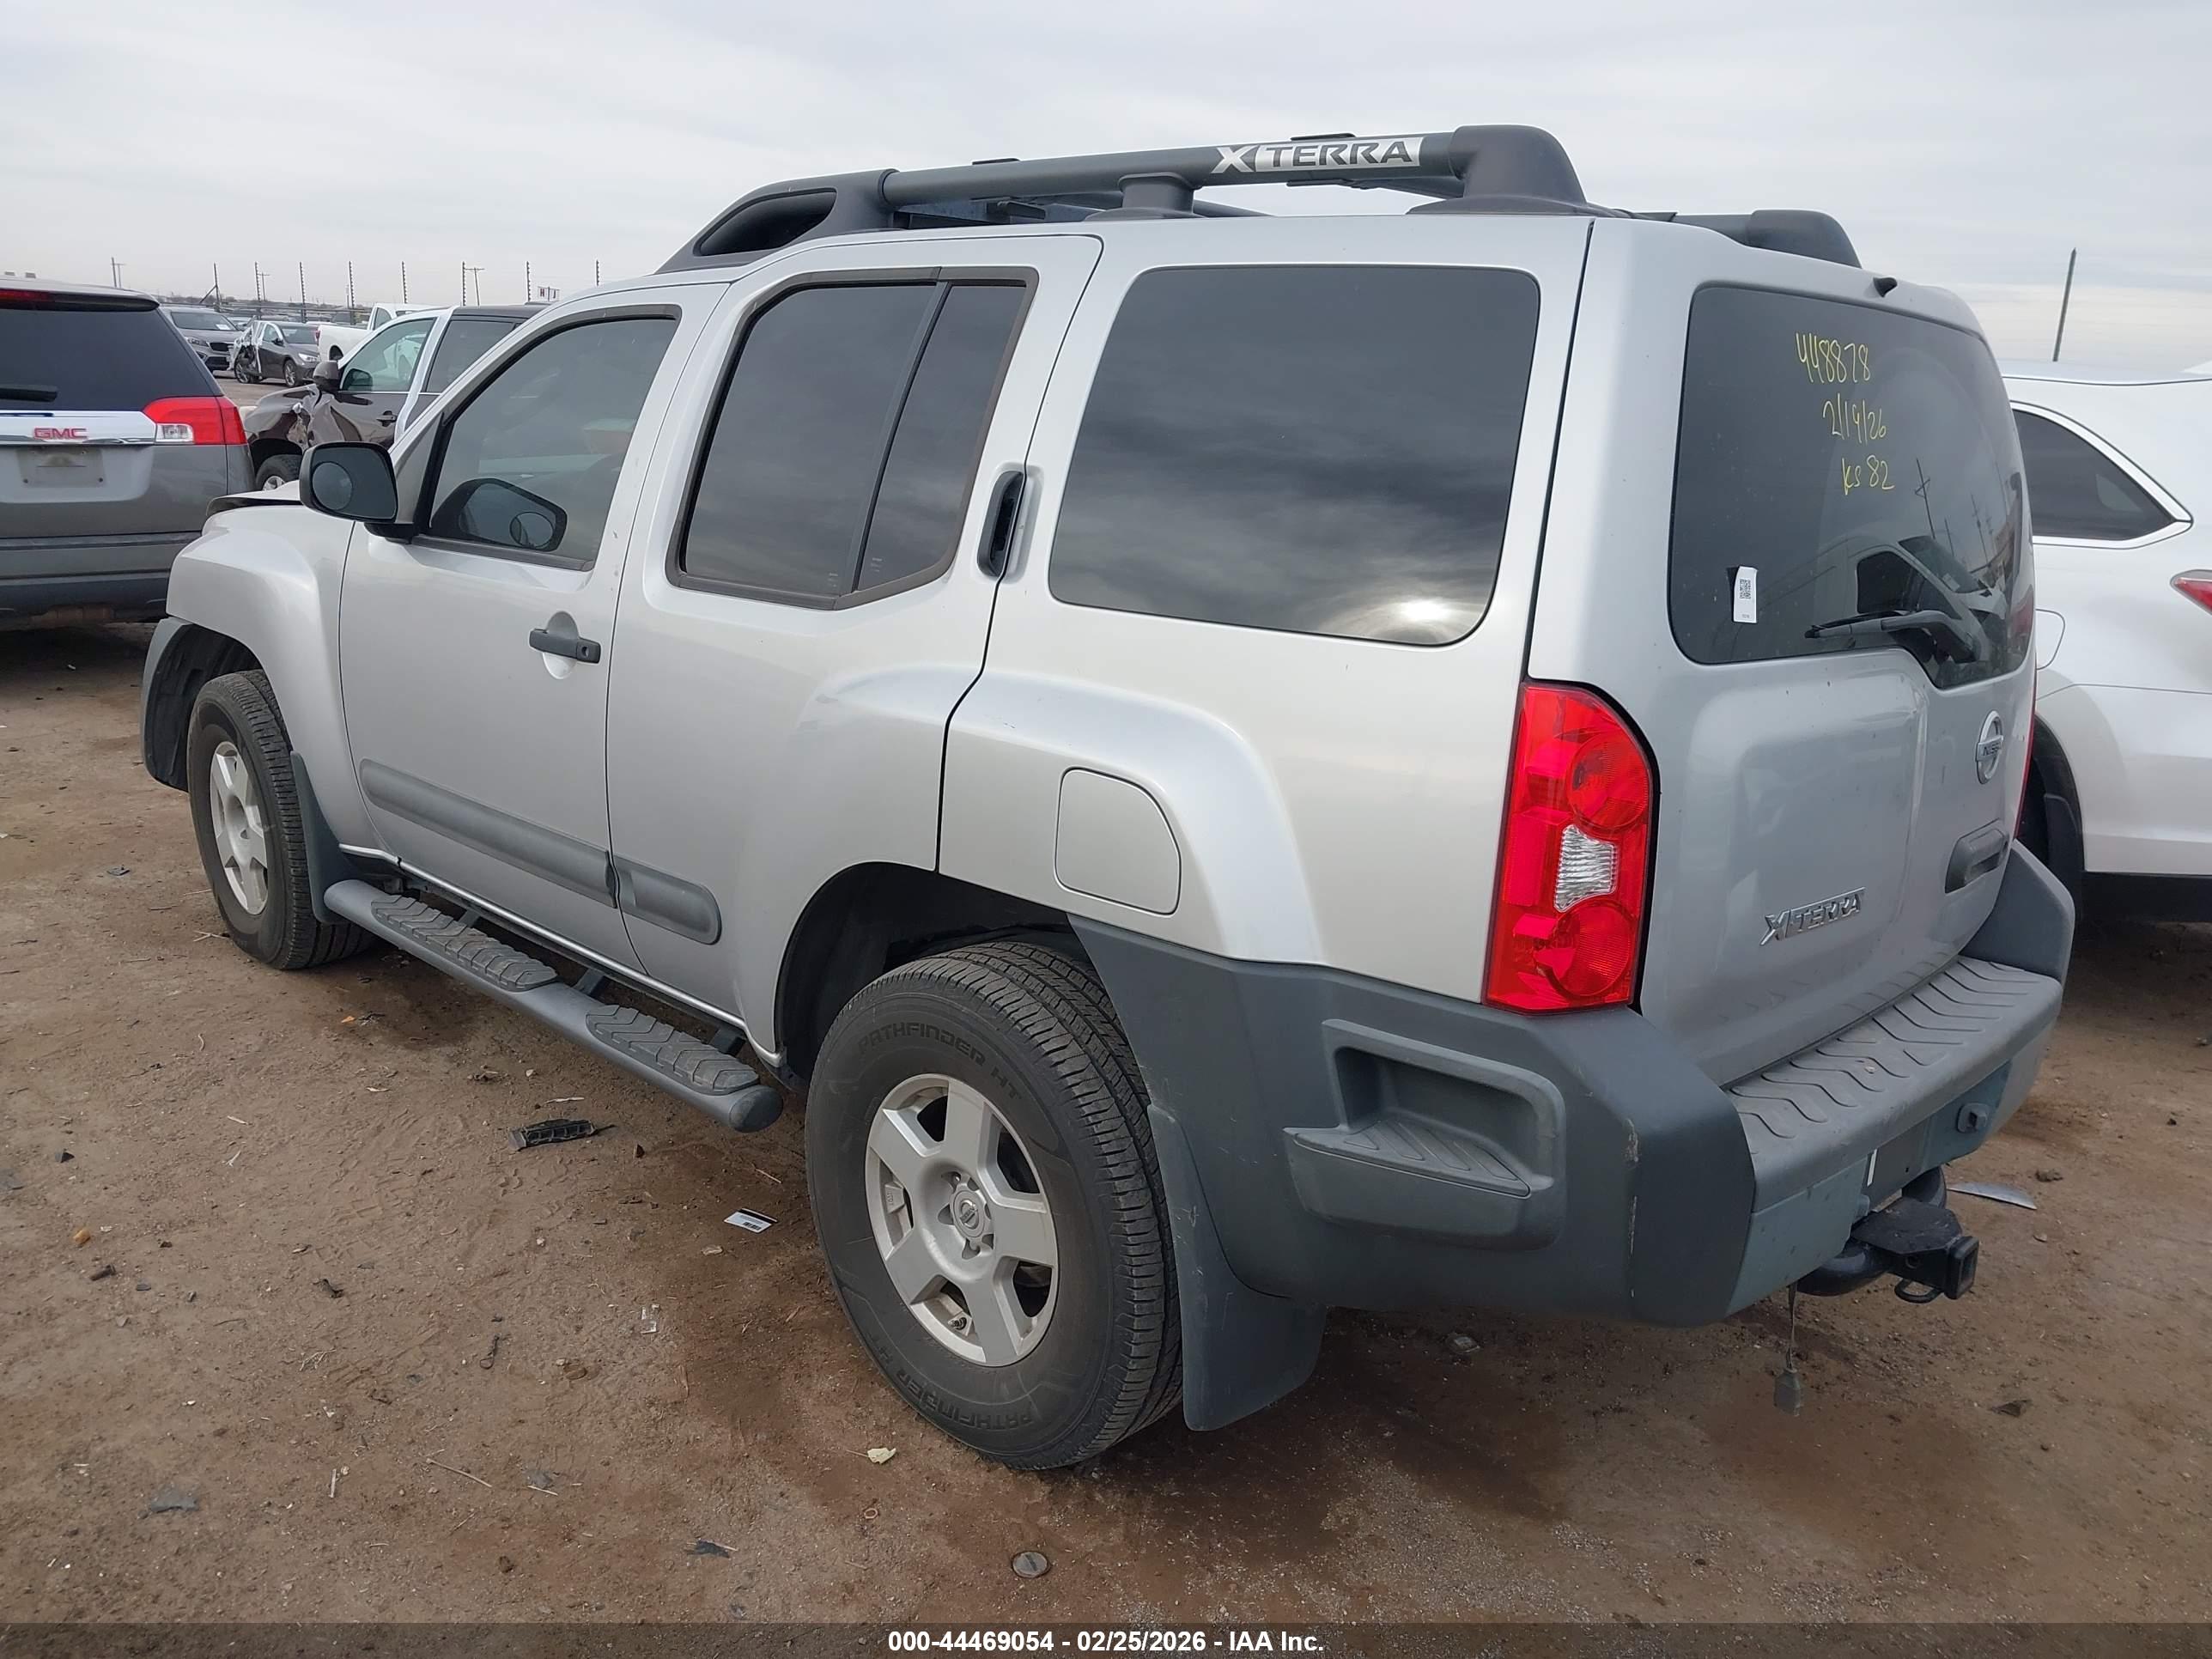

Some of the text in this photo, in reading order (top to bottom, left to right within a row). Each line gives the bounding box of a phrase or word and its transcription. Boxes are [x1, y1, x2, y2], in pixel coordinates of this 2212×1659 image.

[1211, 141, 1415, 173] XTERRA
[1796, 332, 1870, 383] 448878
[34, 428, 88, 440] GMC
[1866, 454, 1895, 490] 82
[1760, 886, 1865, 945] XTERRA
[859, 1022, 987, 1066] PATHFINDER
